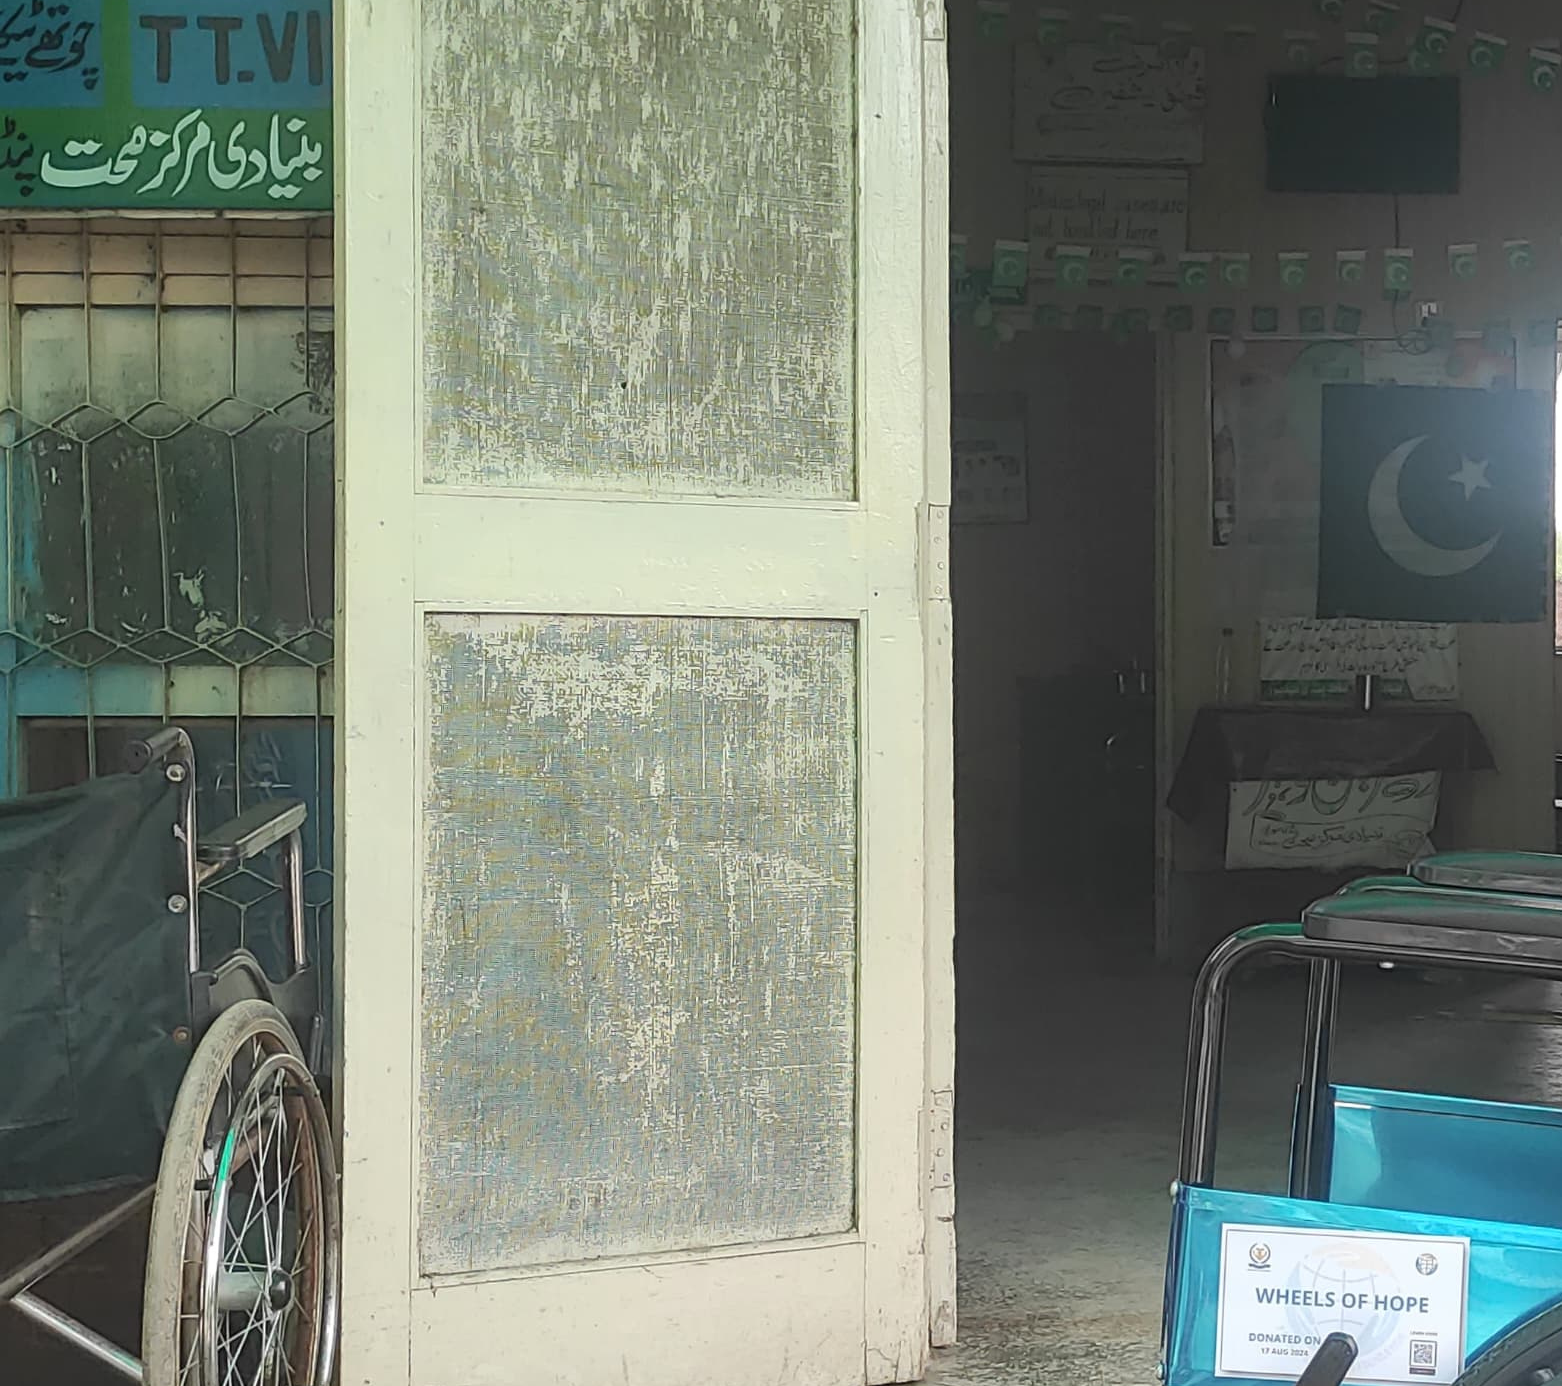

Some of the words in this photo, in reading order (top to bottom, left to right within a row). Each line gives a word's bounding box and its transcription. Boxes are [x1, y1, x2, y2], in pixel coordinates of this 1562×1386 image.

[40, 124, 147, 188] صحت
[134, 108, 212, 198] مرکز
[207, 113, 324, 199] بنیادی
[1255, 1287, 1336, 1308] WHEELS
[1341, 1292, 1369, 1310] OF
[1374, 1294, 1430, 1314] HOPE
[1248, 1332, 1302, 1345] DONATED
[1304, 1335, 1321, 1346] ON
[1260, 1347, 1270, 1355] 17
[1271, 1348, 1289, 1356] AUG
